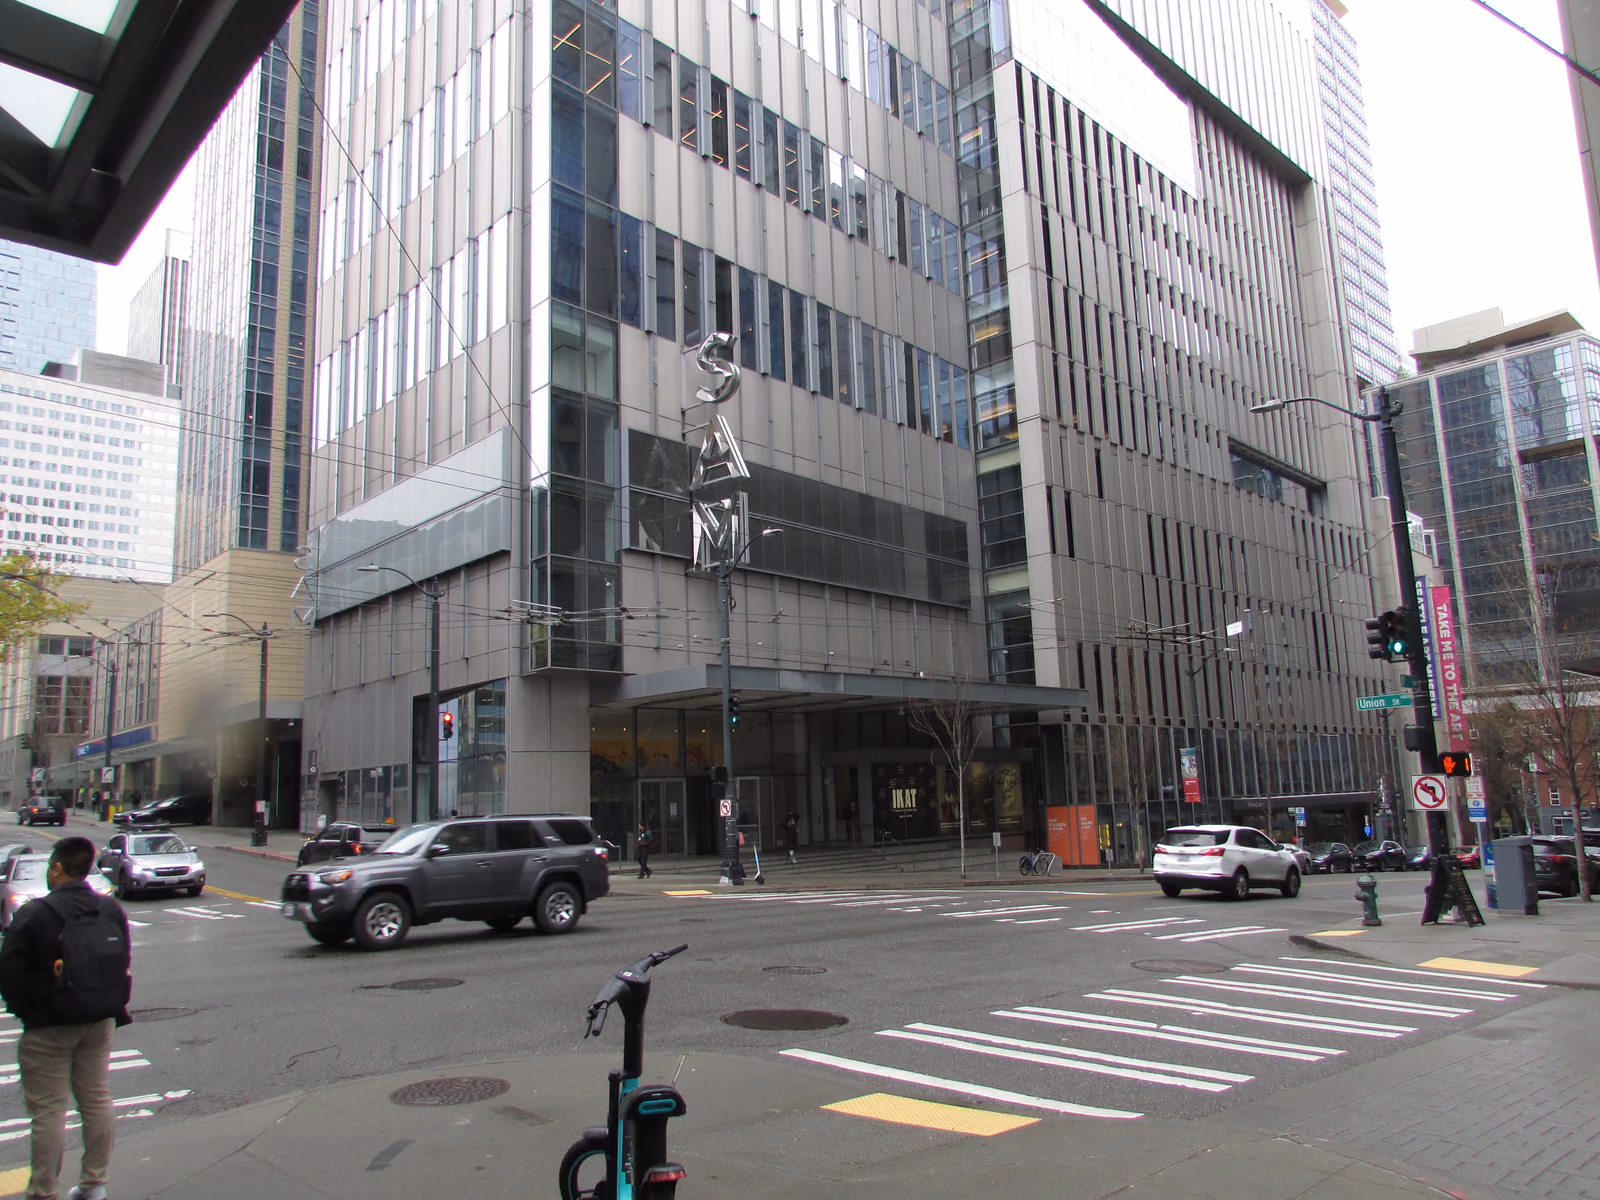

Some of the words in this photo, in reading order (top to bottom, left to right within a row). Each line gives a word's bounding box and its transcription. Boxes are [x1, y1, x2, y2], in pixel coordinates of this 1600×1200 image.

[690, 331, 751, 572] SAM
[1437, 603, 1452, 638] TAKE
[1441, 640, 1454, 660] ME
[1444, 662, 1456, 681] TO
[1360, 698, 1385, 709] Union
[1391, 698, 1401, 706] St
[1446, 683, 1460, 710] THE
[1450, 713, 1464, 740] ART
[892, 788, 917, 809] IKAT
